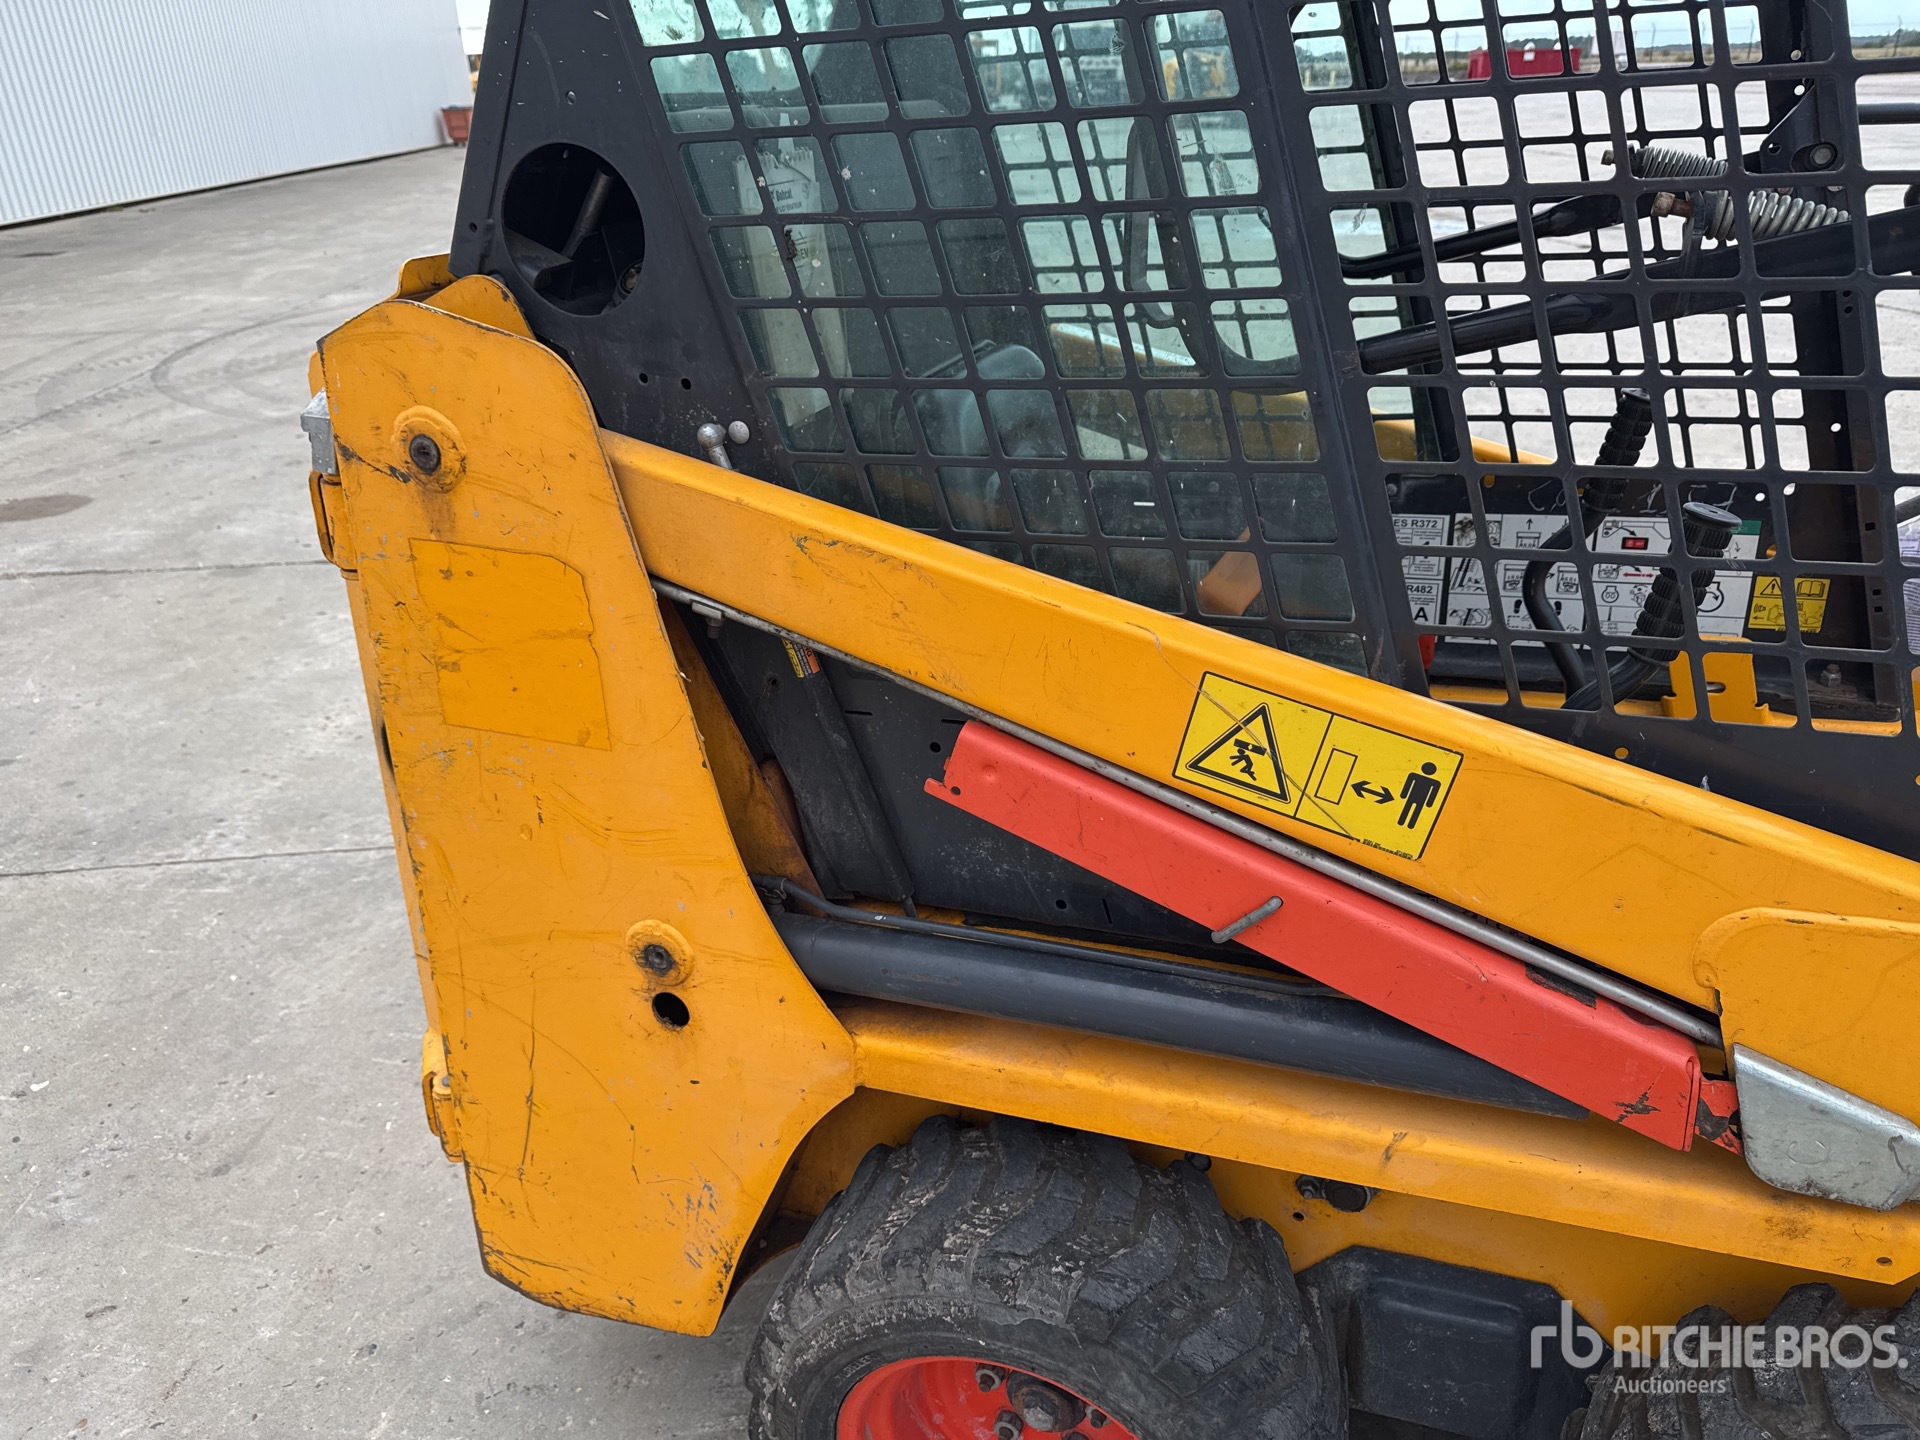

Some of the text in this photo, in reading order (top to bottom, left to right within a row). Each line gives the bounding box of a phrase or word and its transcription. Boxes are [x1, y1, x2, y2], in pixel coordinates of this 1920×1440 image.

[1393, 519, 1438, 529] ES R372
[1407, 585, 1433, 595] R482
[1414, 607, 1428, 622] A
